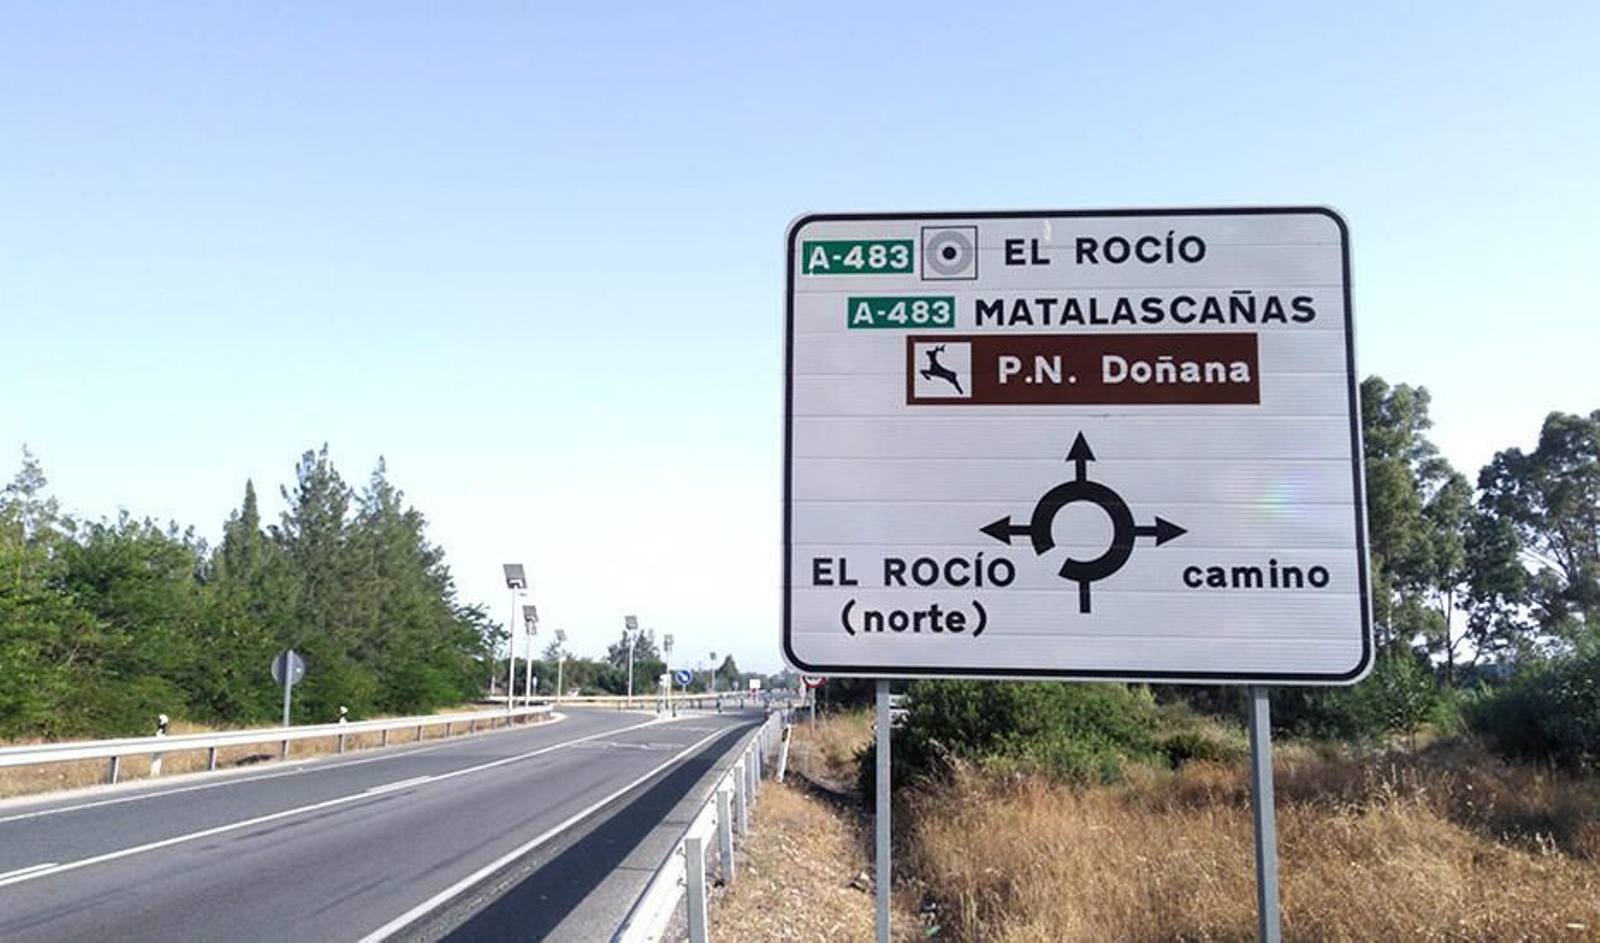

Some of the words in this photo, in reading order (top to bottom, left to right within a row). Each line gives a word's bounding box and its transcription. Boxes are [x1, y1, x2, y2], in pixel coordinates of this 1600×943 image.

[808, 243, 911, 271] A-483
[1005, 238, 1051, 265] EL
[1076, 231, 1206, 264] ROCÍO
[852, 301, 952, 326] A-483
[975, 290, 1317, 327] MATALASCAÑAS
[998, 356, 1077, 384] P.N.
[1102, 354, 1251, 384] Doñana
[812, 557, 858, 586] EL
[884, 552, 1016, 587] ROCÍO
[1183, 559, 1331, 589] camino
[841, 600, 988, 637] (norte)
